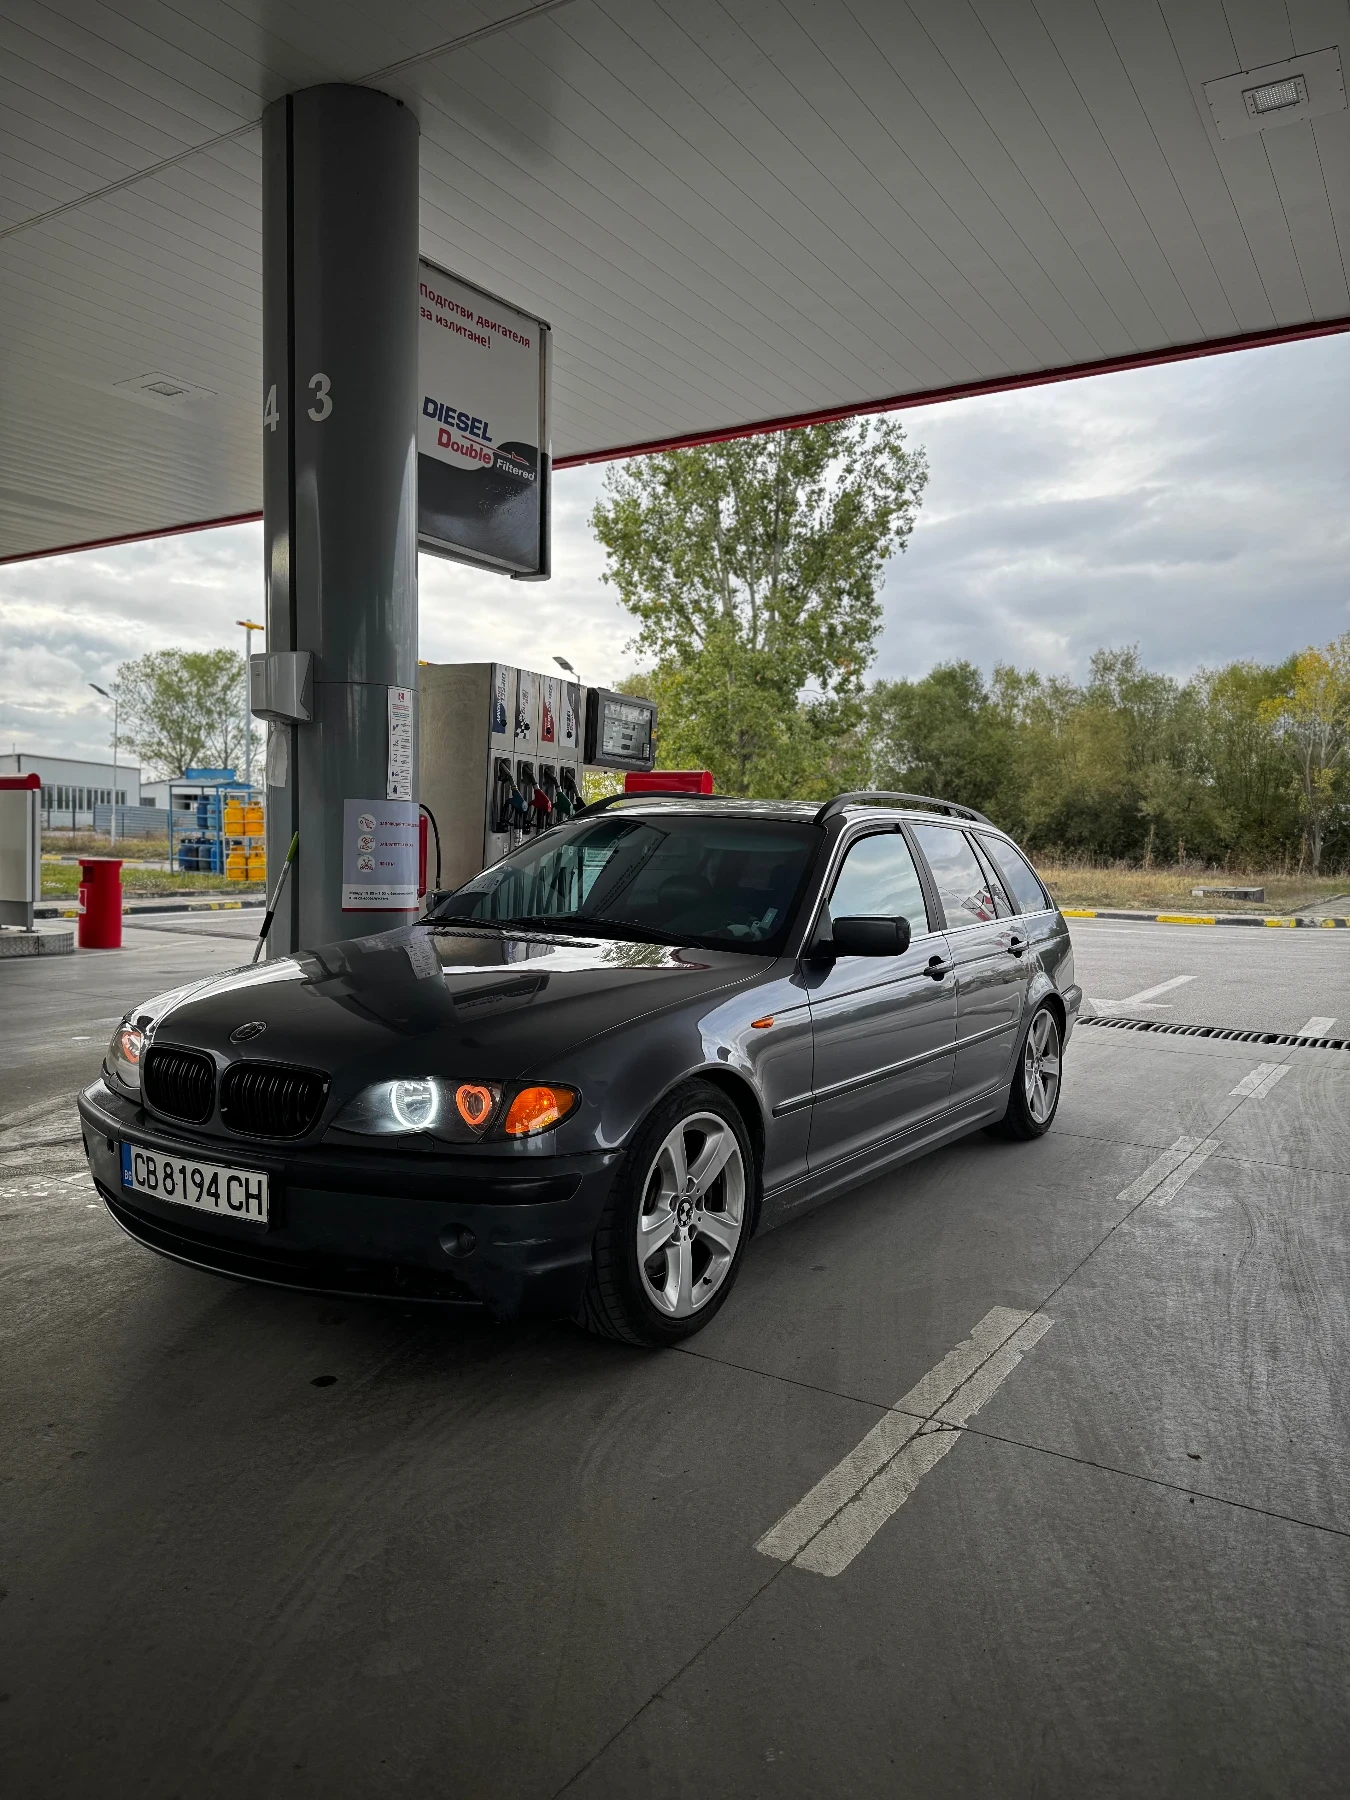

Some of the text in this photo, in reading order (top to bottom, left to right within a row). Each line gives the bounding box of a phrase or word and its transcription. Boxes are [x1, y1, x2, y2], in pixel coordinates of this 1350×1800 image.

[419, 282, 530, 348] Подготви двигателя
[420, 306, 491, 349] за излитане!
[263, 383, 280, 432] 4
[307, 372, 333, 422] 3
[422, 395, 493, 442] DIESEL
[437, 427, 492, 465] Double
[496, 458, 536, 481] Filtered
